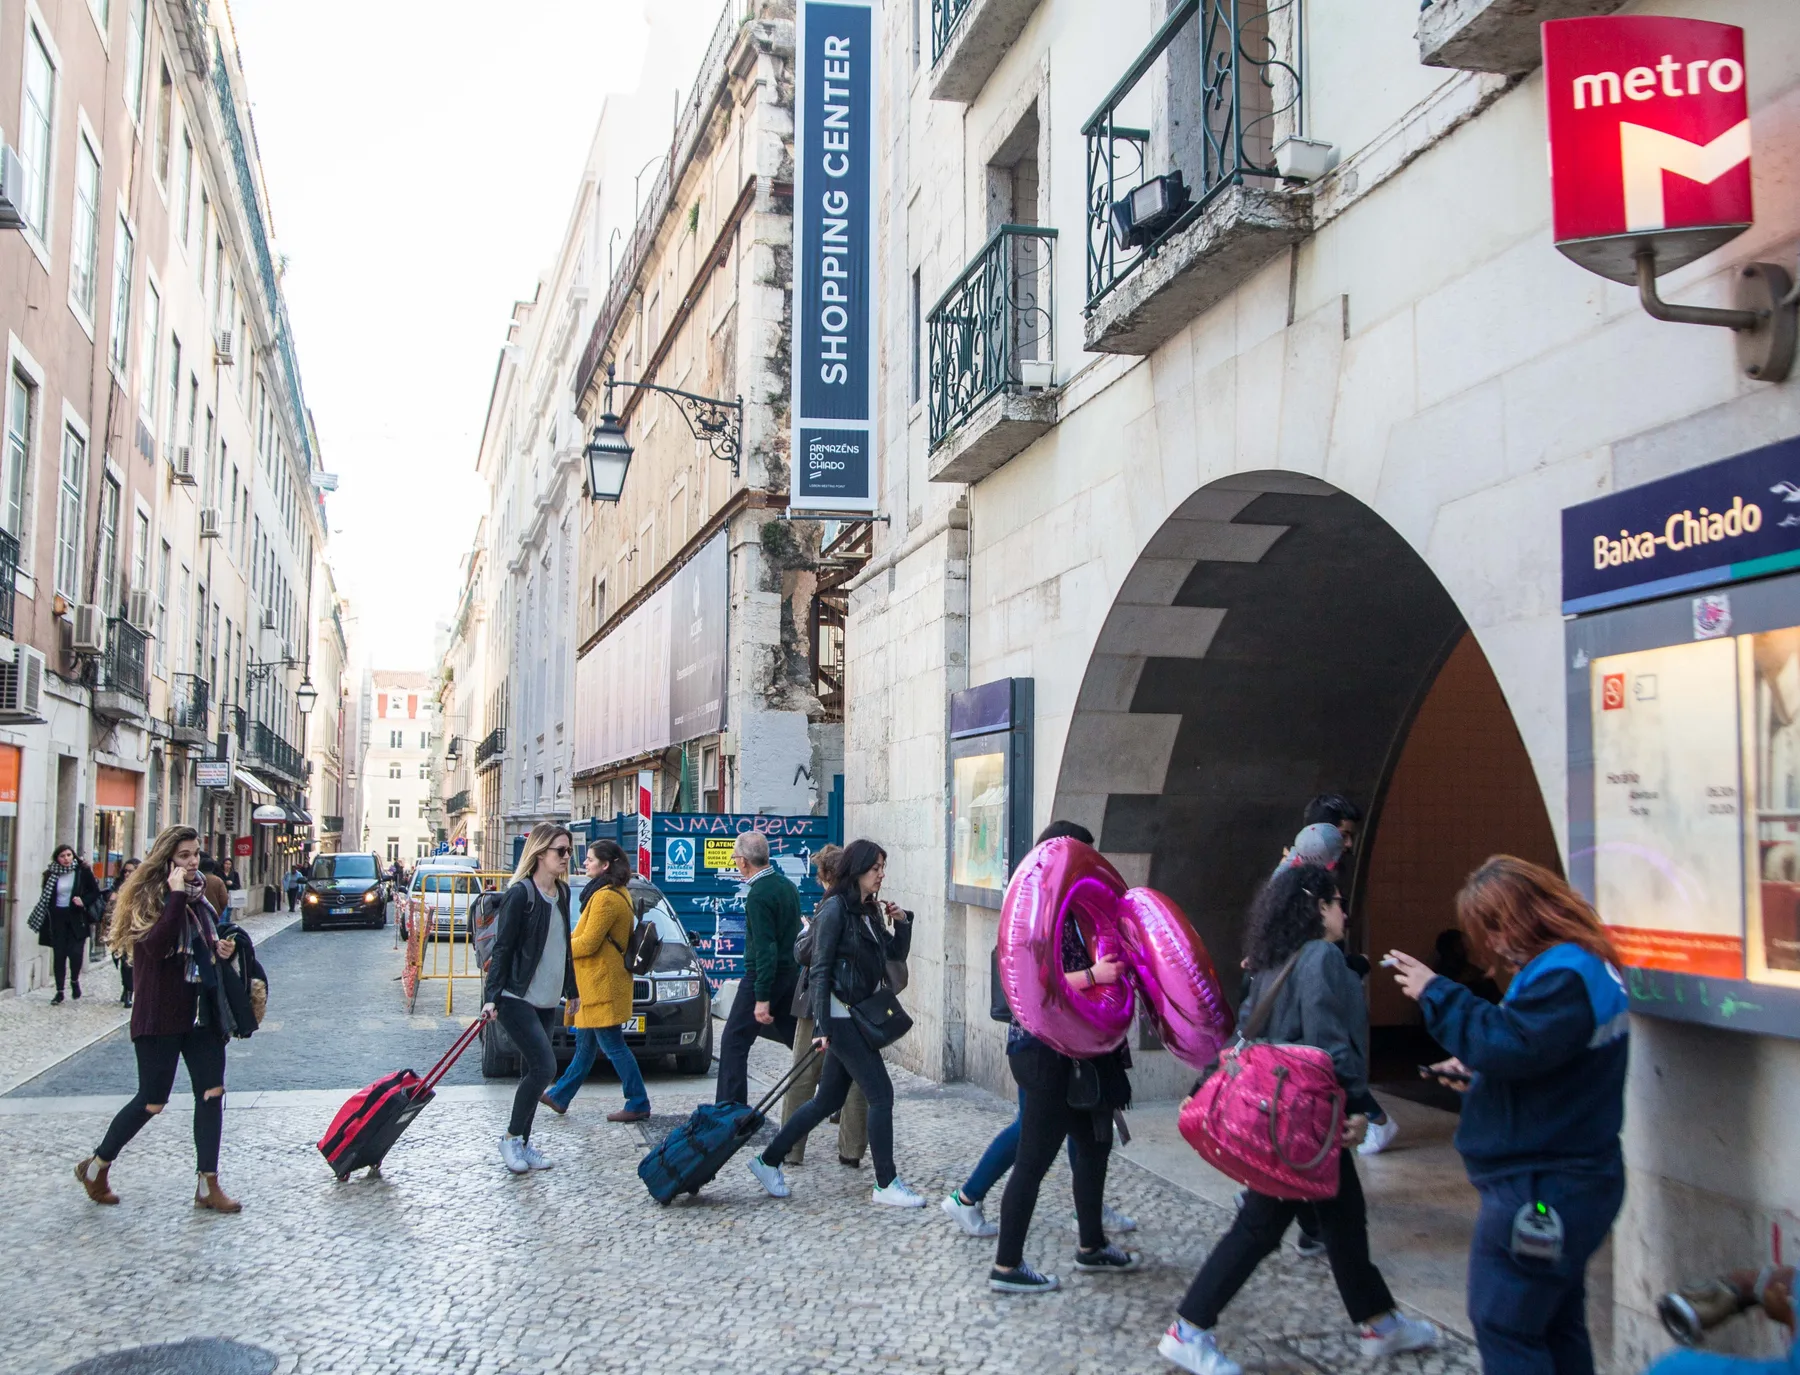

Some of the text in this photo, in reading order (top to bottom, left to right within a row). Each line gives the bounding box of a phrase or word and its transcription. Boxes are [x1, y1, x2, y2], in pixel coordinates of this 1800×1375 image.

[1572, 54, 1744, 110] metro
[820, 35, 851, 385] SHOPPING CENTER
[809, 443, 859, 454] ARMAZÉNS
[809, 452, 824, 461] DO
[809, 460, 845, 470] CHIADO
[1593, 495, 1763, 570] Baixa-Chiado
[442, 842, 448, 851] P
